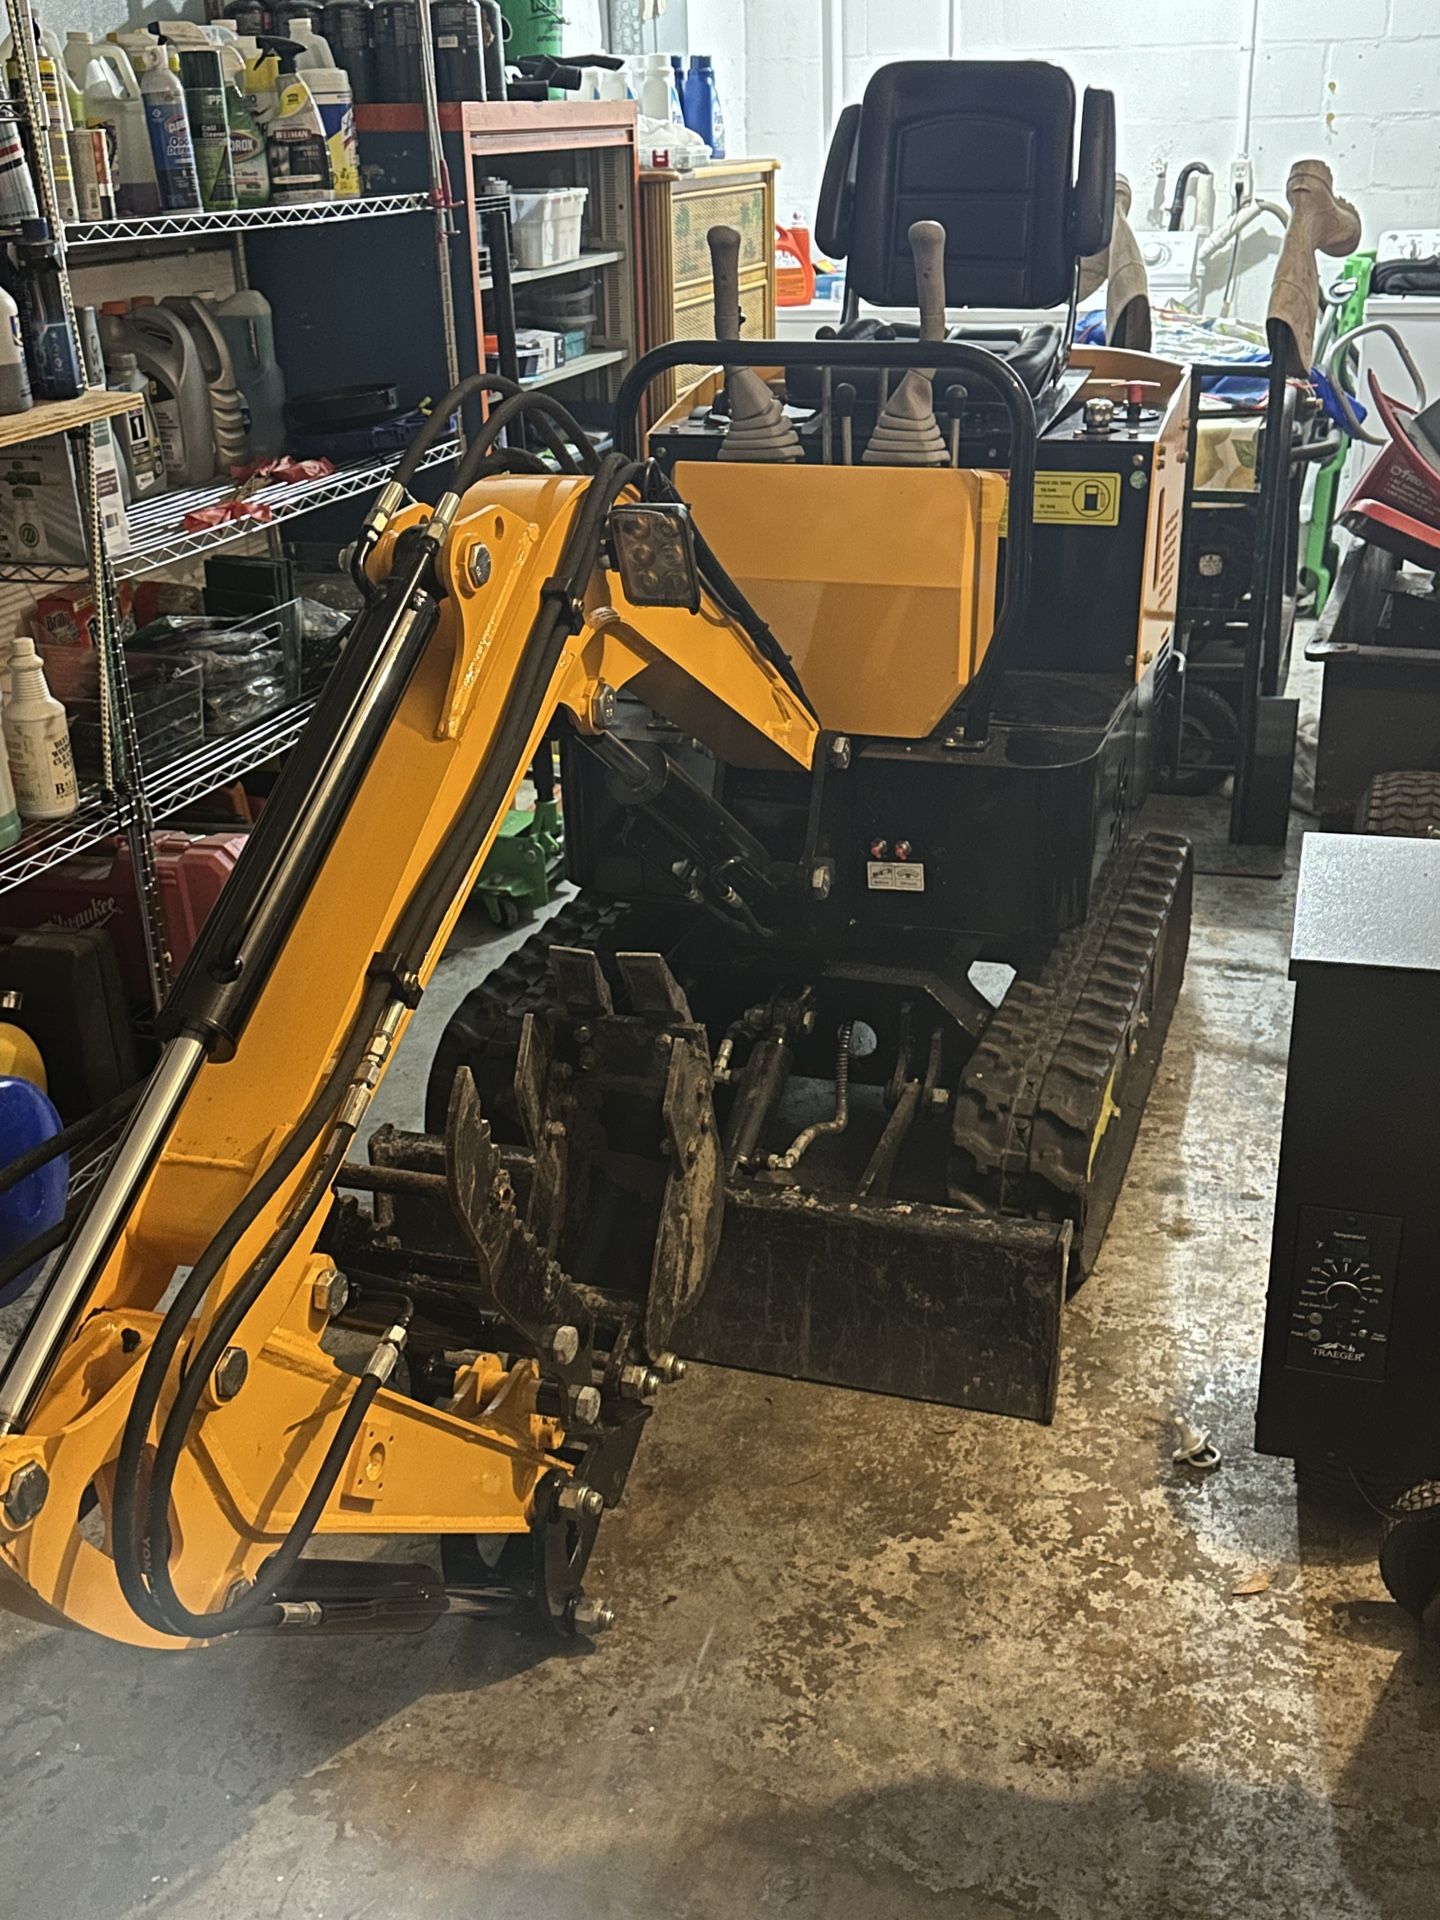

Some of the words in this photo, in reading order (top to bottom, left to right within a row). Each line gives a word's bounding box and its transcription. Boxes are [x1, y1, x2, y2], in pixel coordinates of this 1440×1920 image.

[275, 131, 309, 139] WEIMAN
[170, 137, 189, 146] ODO
[230, 139, 254, 151] OROX
[47, 897, 116, 928] ilwaukee
[1312, 1347, 1363, 1362] TRAEGER
